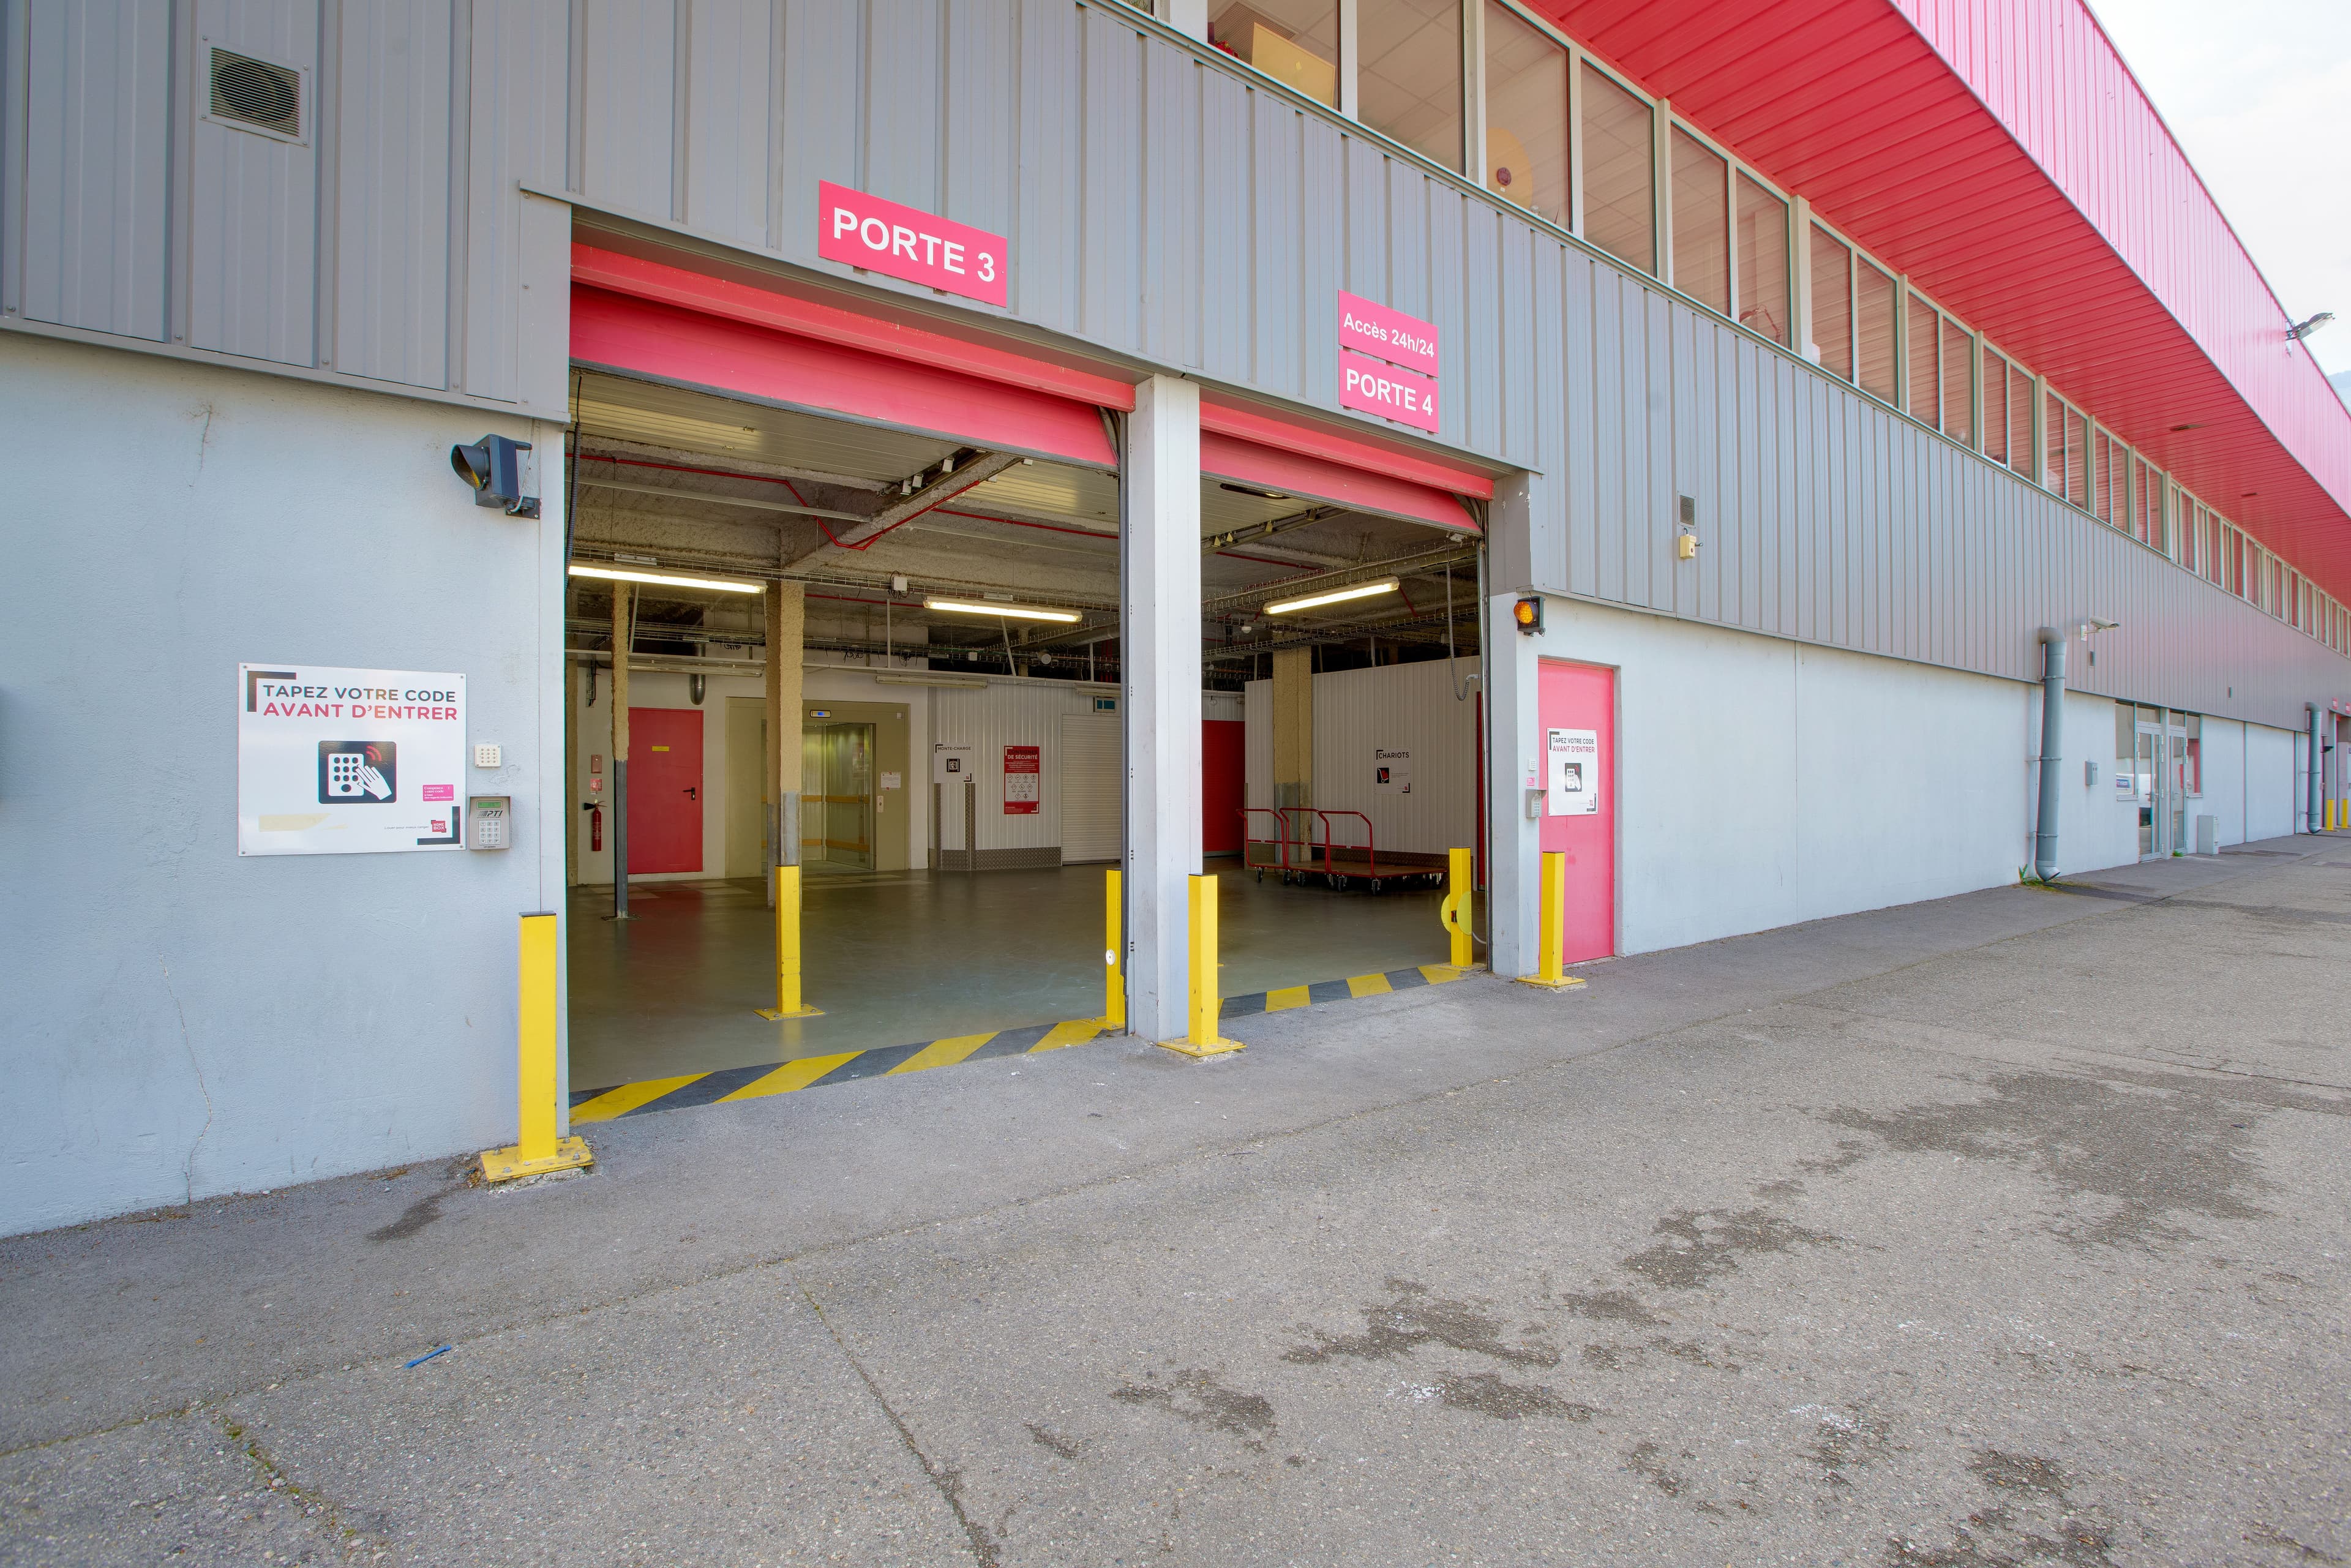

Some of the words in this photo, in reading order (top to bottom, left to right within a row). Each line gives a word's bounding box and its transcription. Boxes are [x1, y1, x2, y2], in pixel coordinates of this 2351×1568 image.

[834, 207, 966, 275] PORTE
[977, 252, 995, 282] 3
[1343, 313, 1387, 341] Accès
[1392, 329, 1434, 358] 24h/24
[1347, 368, 1417, 411] PORTE
[1422, 394, 1433, 416] 4
[263, 685, 328, 699] TAPEZ
[334, 687, 399, 700] VOTRE
[405, 689, 456, 703] CODE
[263, 702, 344, 718] AVANT
